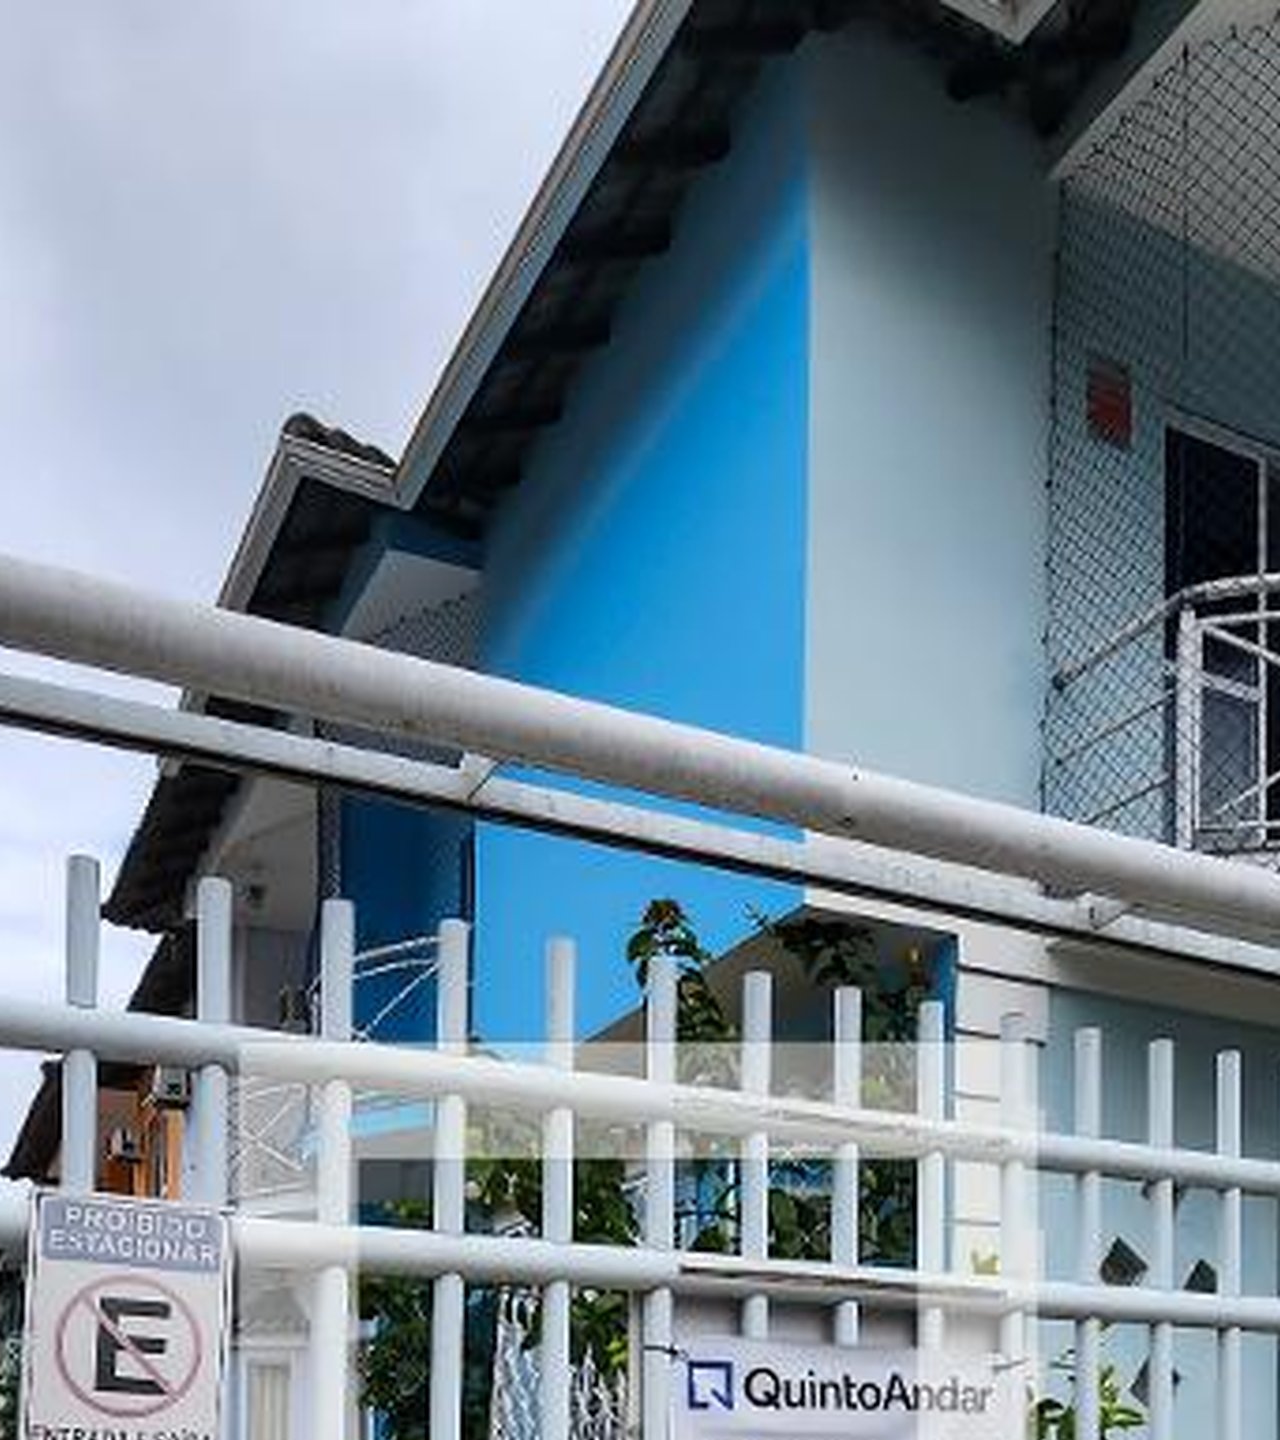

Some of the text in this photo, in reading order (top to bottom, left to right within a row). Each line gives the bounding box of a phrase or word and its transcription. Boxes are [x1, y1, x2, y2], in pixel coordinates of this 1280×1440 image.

[66, 1205, 206, 1239] PROIBIDO
[49, 1228, 218, 1266] ESTACIONAR
[743, 1367, 993, 1413] QuintoAndar
